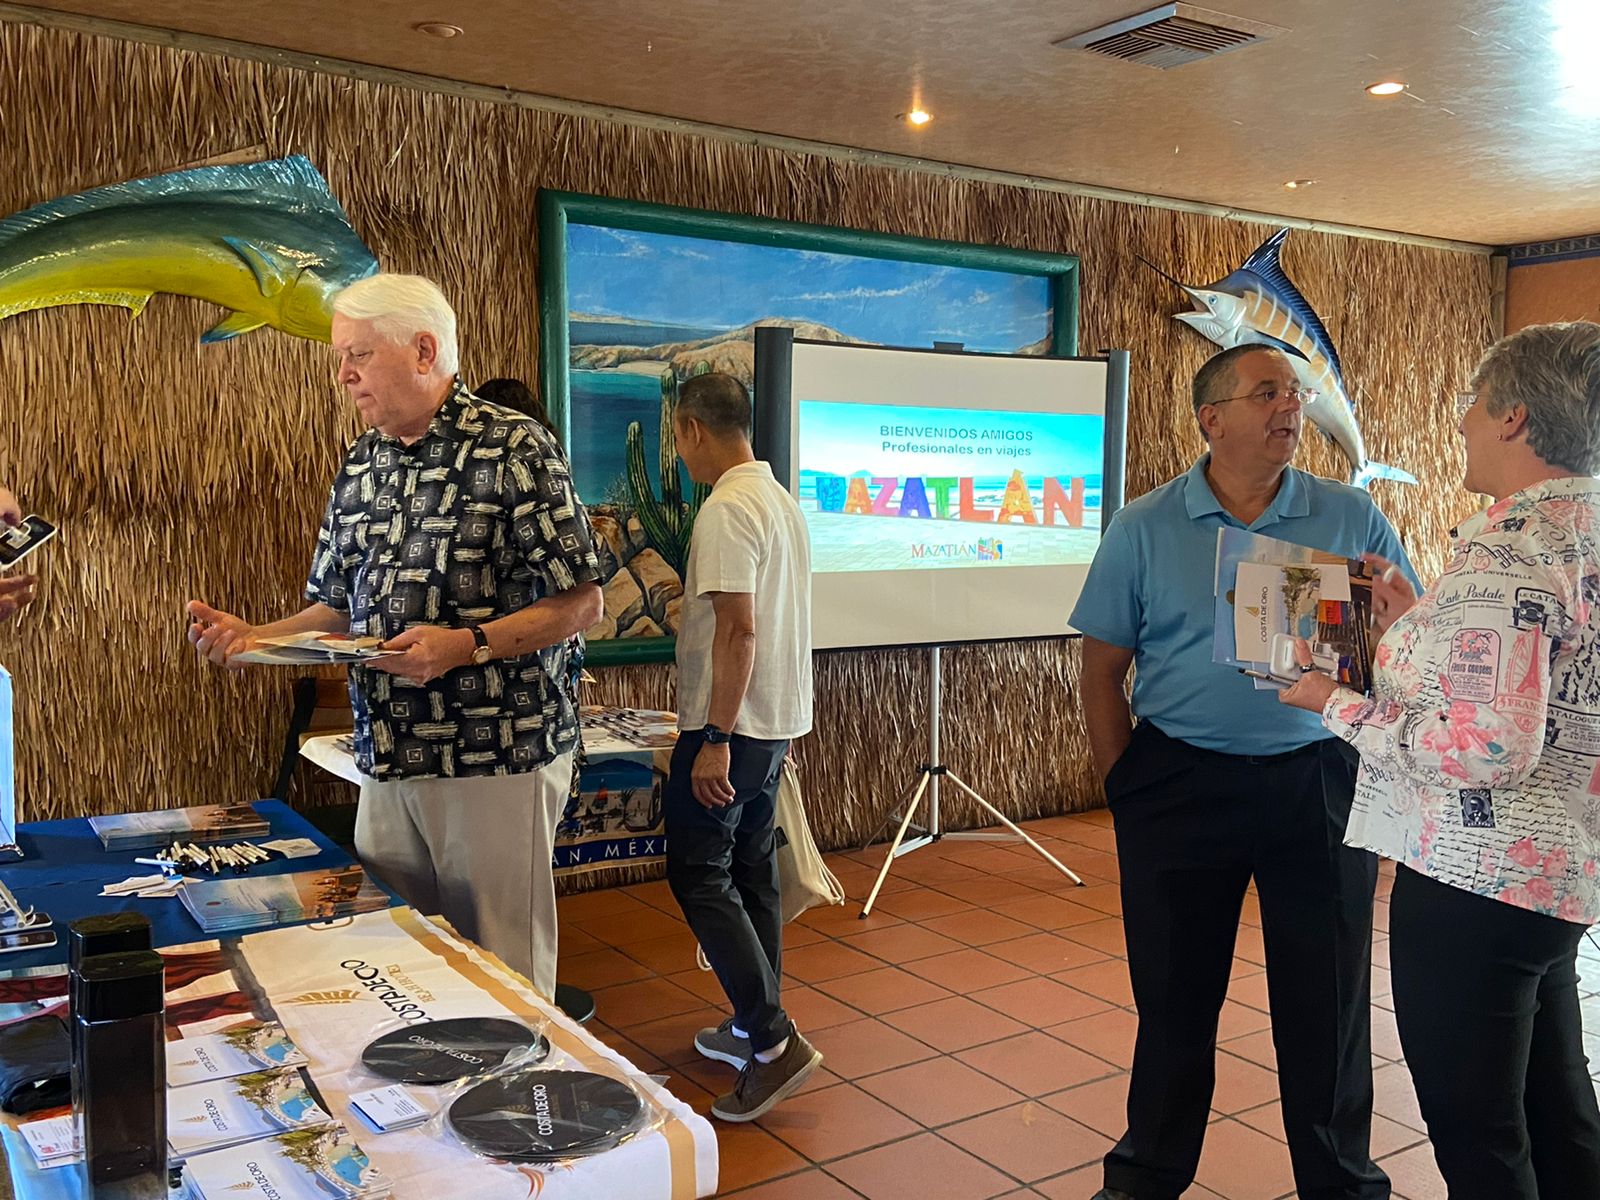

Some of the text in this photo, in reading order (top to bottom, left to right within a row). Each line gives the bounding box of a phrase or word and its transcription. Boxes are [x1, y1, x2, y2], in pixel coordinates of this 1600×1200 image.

[880, 425, 1033, 442] BIENVENIDOS AMIGOS
[881, 441, 1031, 458] Profesionales en viajes
[1463, 582, 1505, 600] Postale
[1530, 592, 1557, 605] CATA
[1508, 698, 1545, 712] FRANC
[1547, 709, 1597, 724] ATALOGUE
[551, 838, 667, 866] AN, MÉXI
